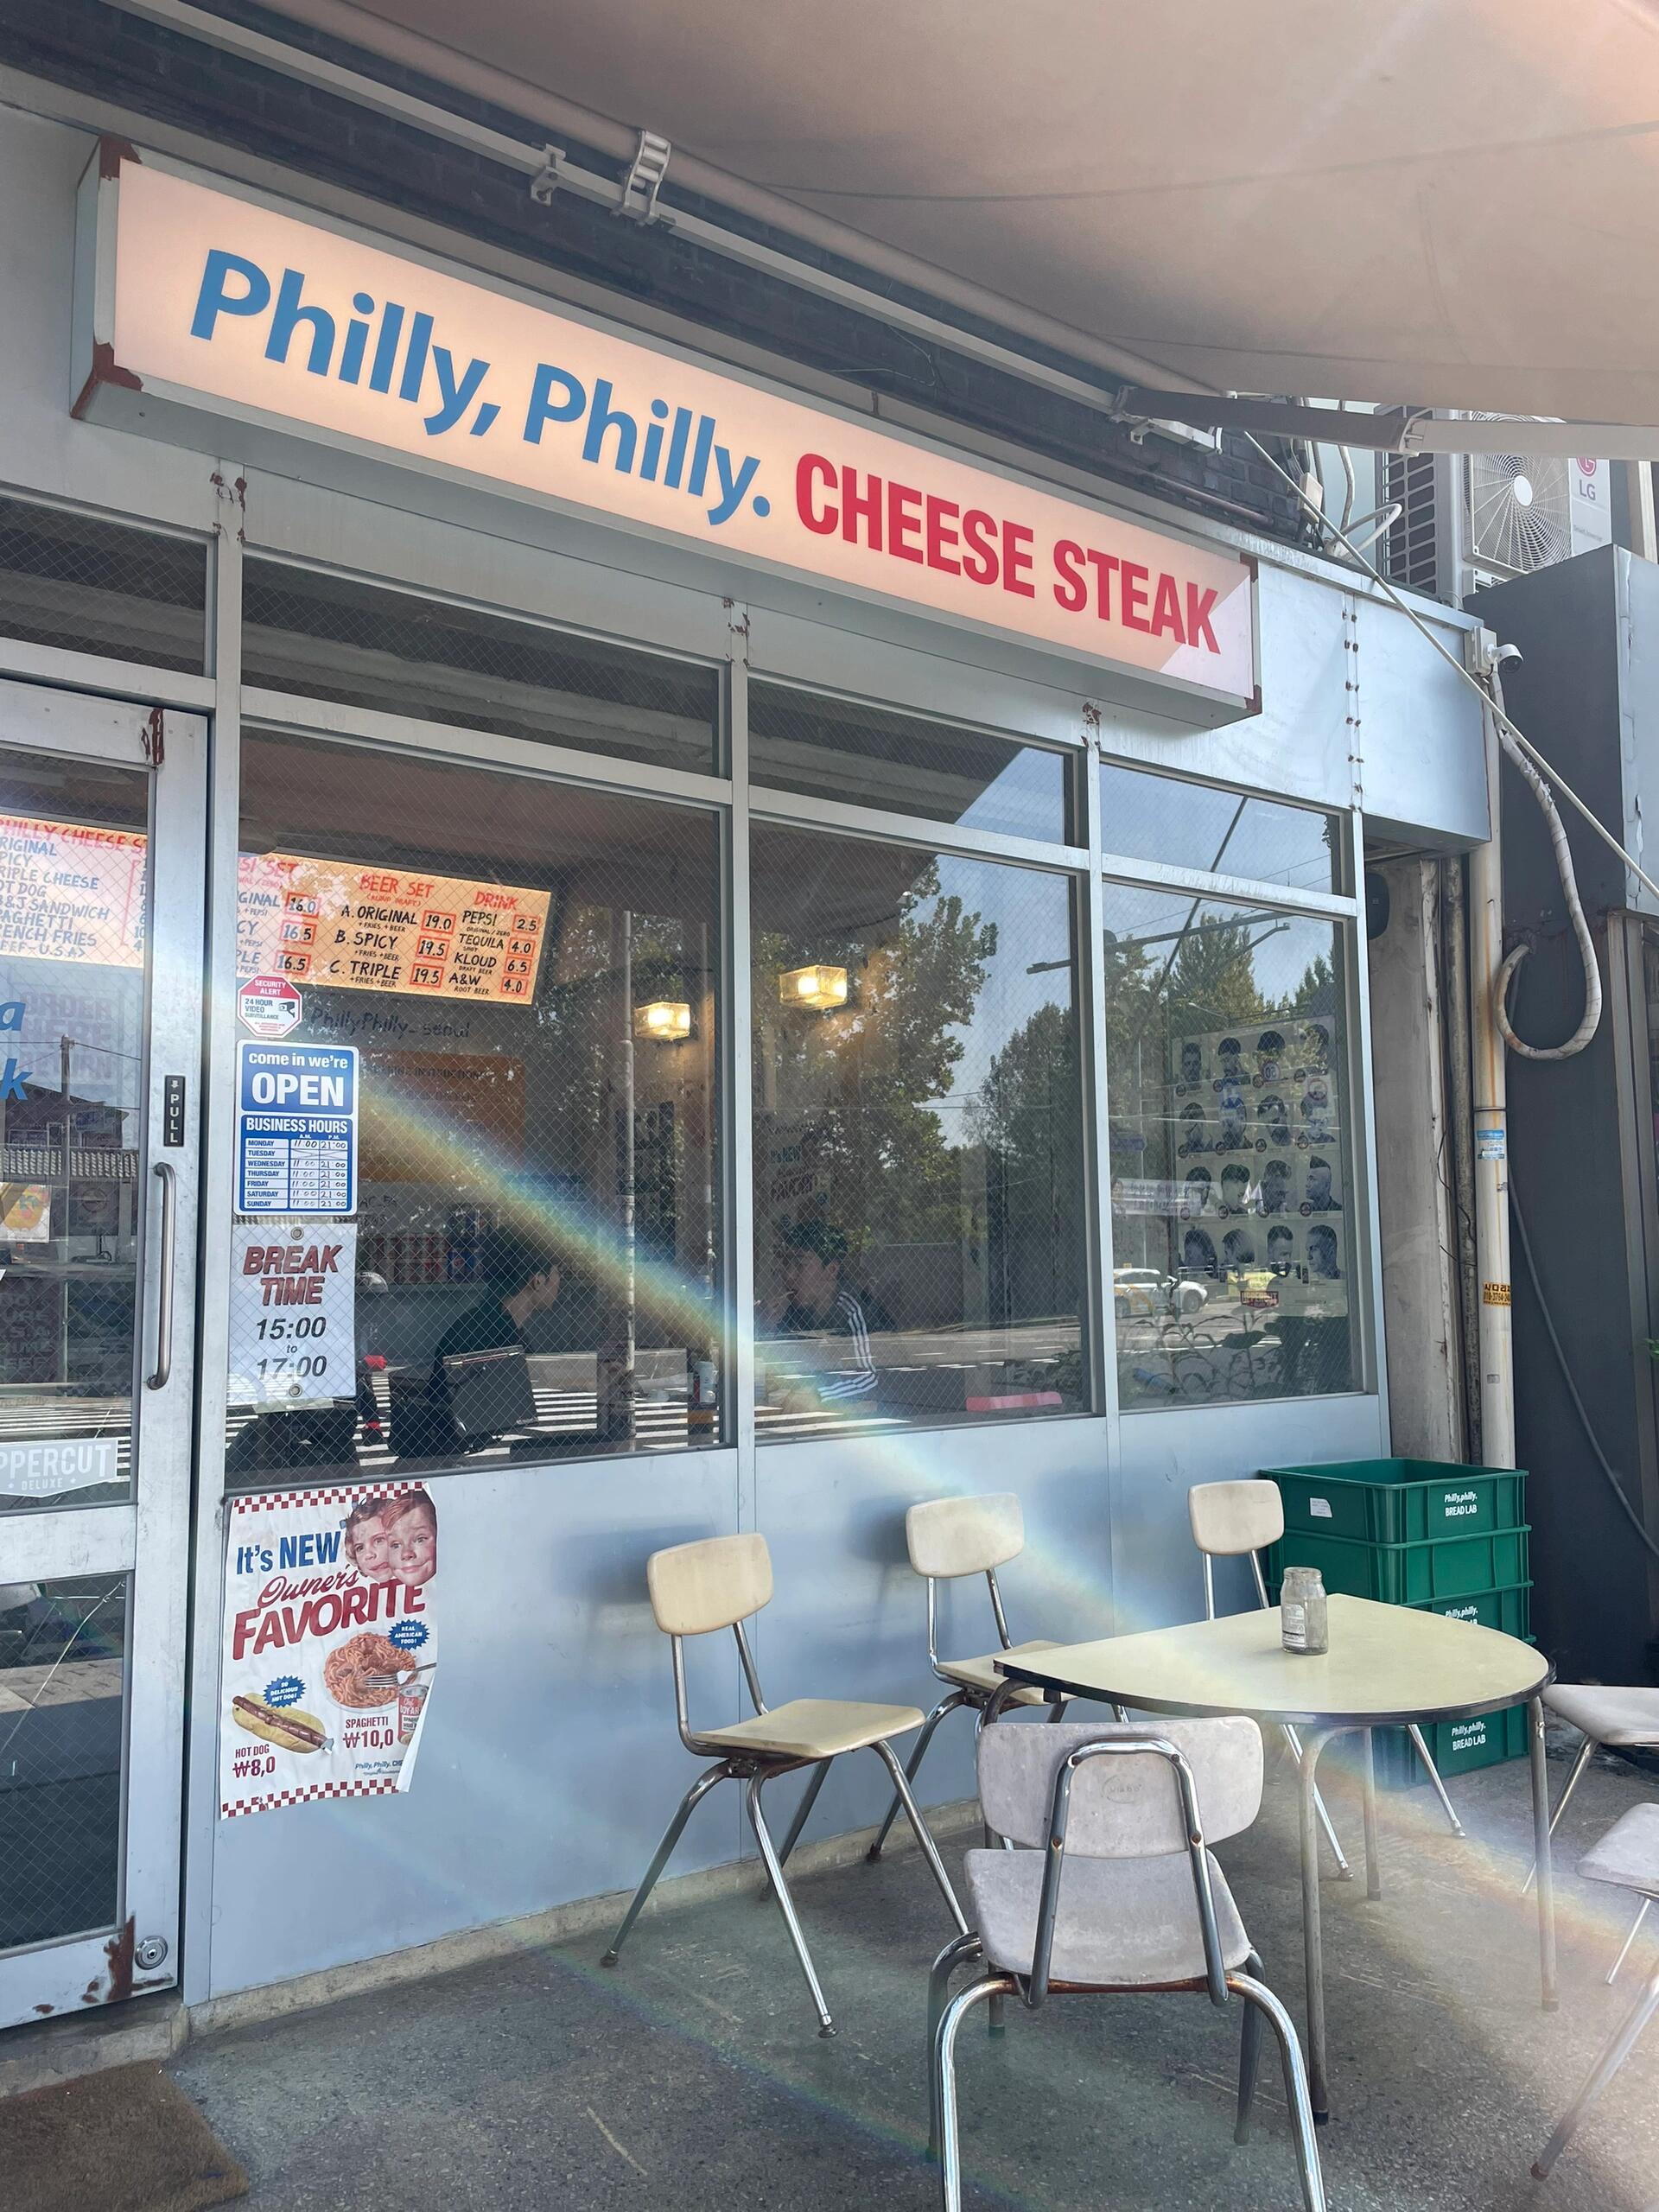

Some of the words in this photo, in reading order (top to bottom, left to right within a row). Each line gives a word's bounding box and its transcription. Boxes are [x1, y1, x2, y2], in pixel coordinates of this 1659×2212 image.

[189, 248, 502, 436] Philly,
[523, 361, 772, 526] Philly.
[795, 453, 1036, 599] CHEESE
[1052, 539, 1222, 655] STEAK
[1579, 480, 1596, 501] LG
[60, 829, 126, 852] CHEESE
[18, 882, 47, 898] DOG
[44, 872, 99, 889] CHEESE
[359, 874, 398, 893] BEER
[407, 882, 435, 899] SET
[29, 899, 110, 920] SANDWICH
[289, 897, 316, 912] 16.0
[474, 891, 518, 910] DRINK
[358, 906, 417, 925] ORIGINAL
[425, 914, 452, 930] 19.0
[462, 911, 497, 926] PEPSI
[517, 918, 537, 931] 2.5
[53, 930, 97, 946] FRIES
[283, 925, 311, 941] 16.5
[353, 932, 398, 950] SPICY
[418, 940, 445, 957] 19.5
[459, 933, 504, 950] TEQUILA
[512, 941, 531, 954] 4.0
[277, 955, 305, 970] 16.5
[454, 952, 497, 968] KLOUD
[507, 960, 527, 972] 6.5
[350, 961, 401, 980] TRIPLE
[413, 968, 439, 984] 19.5
[255, 980, 286, 988] SECURITY
[448, 973, 480, 985] A&W
[504, 979, 523, 993] 4.0
[249, 1053, 289, 1065] come
[292, 1052, 305, 1066] in
[251, 1071, 345, 1107] OPEN
[169, 1094, 180, 1143] PULL
[246, 1117, 307, 1132] BUSINESS
[308, 1120, 348, 1134] HOURS
[243, 1244, 344, 1275] BREAK
[260, 1275, 326, 1306] TIME
[256, 1316, 327, 1340] 15:00
[286, 1344, 297, 1353] to
[257, 1355, 327, 1380] 17:00
[22, 1478, 63, 1491] DELUXE
[1445, 1505, 1465, 1517] BREAD
[1465, 1503, 1478, 1514] LAB
[237, 1545, 273, 1574] It's
[279, 1531, 341, 1569] NEW
[257, 1564, 359, 1608] Owner's
[232, 1578, 426, 1660] FAVORITE
[270, 1687, 298, 1696] DELICIOUS
[346, 1717, 389, 1729] SPAGHETTI
[235, 1746, 251, 1758] HOT
[253, 1744, 270, 1756] DOG
[1452, 1737, 1472, 1751] BREAD
[1473, 1734, 1486, 1745] LAB
